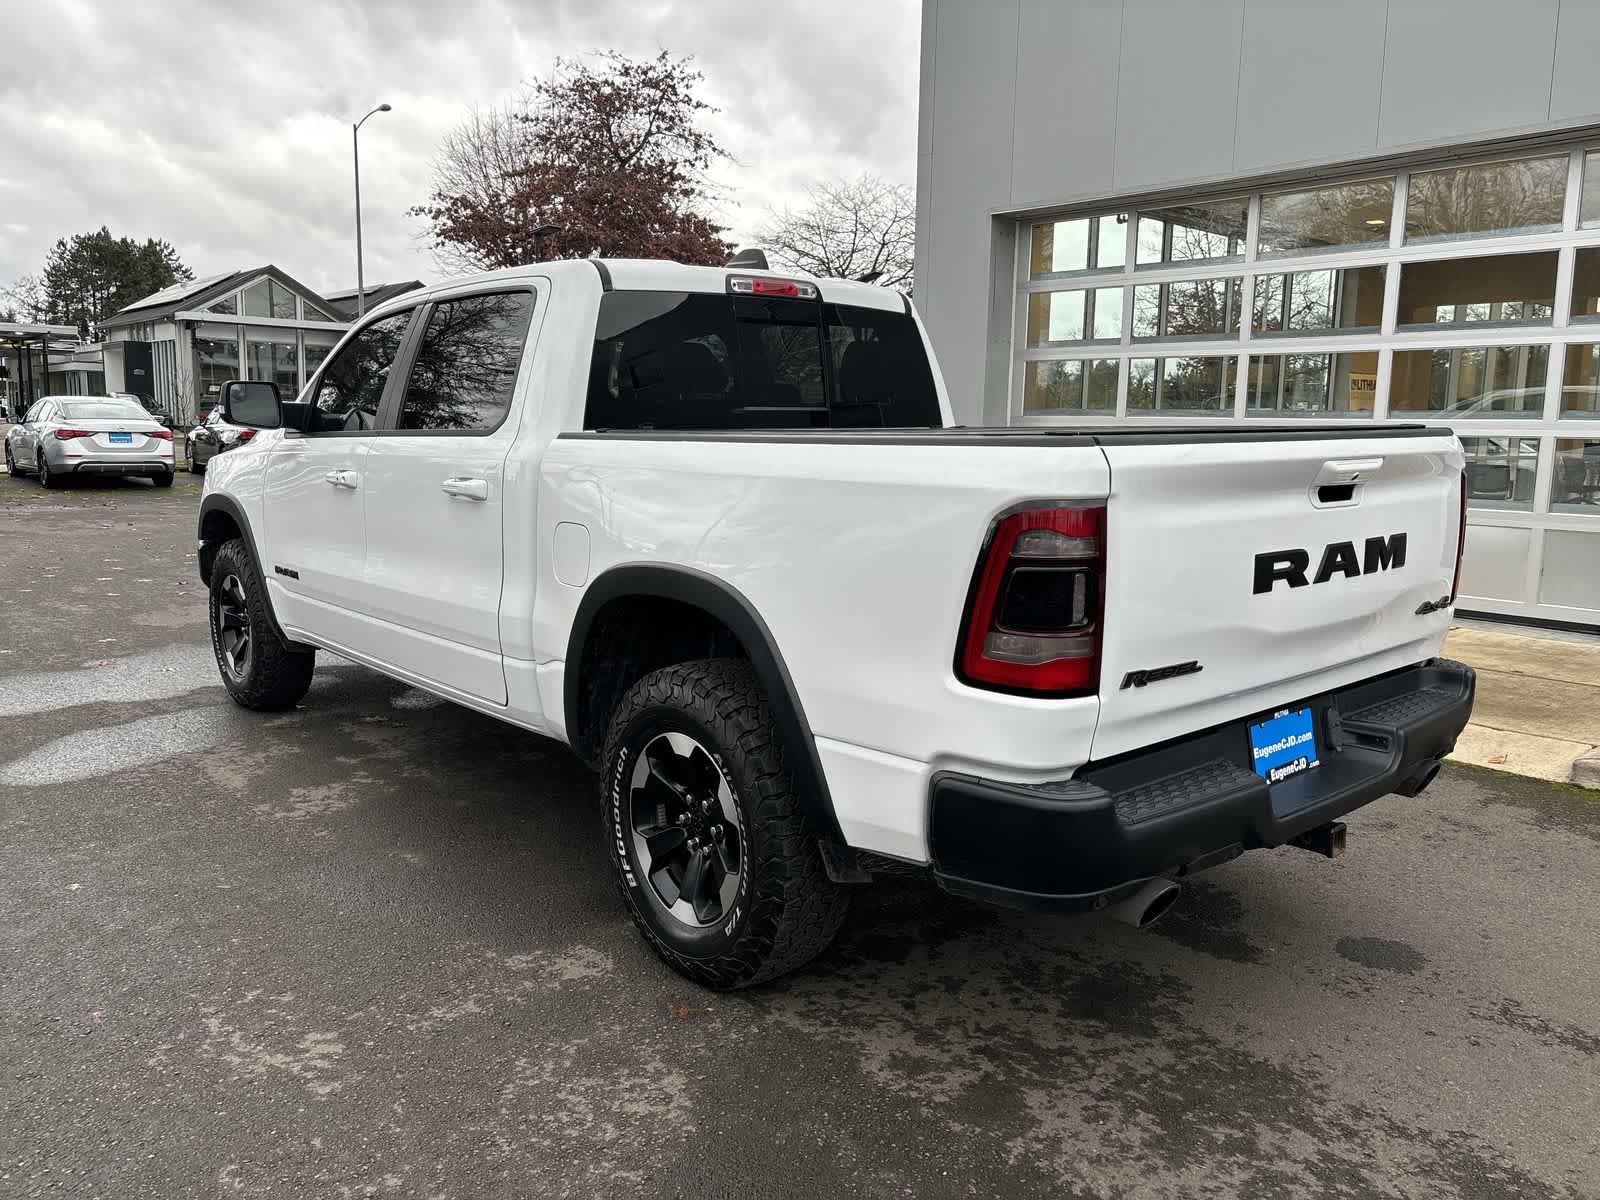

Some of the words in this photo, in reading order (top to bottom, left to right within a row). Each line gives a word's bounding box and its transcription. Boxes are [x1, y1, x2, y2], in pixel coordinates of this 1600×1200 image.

[1357, 379, 1376, 391] LITHI
[1253, 532, 1407, 594] RAM
[1119, 660, 1204, 690] REBEL
[1253, 731, 1313, 759] EugeneCJD.com
[612, 746, 638, 888] BFGoodrich
